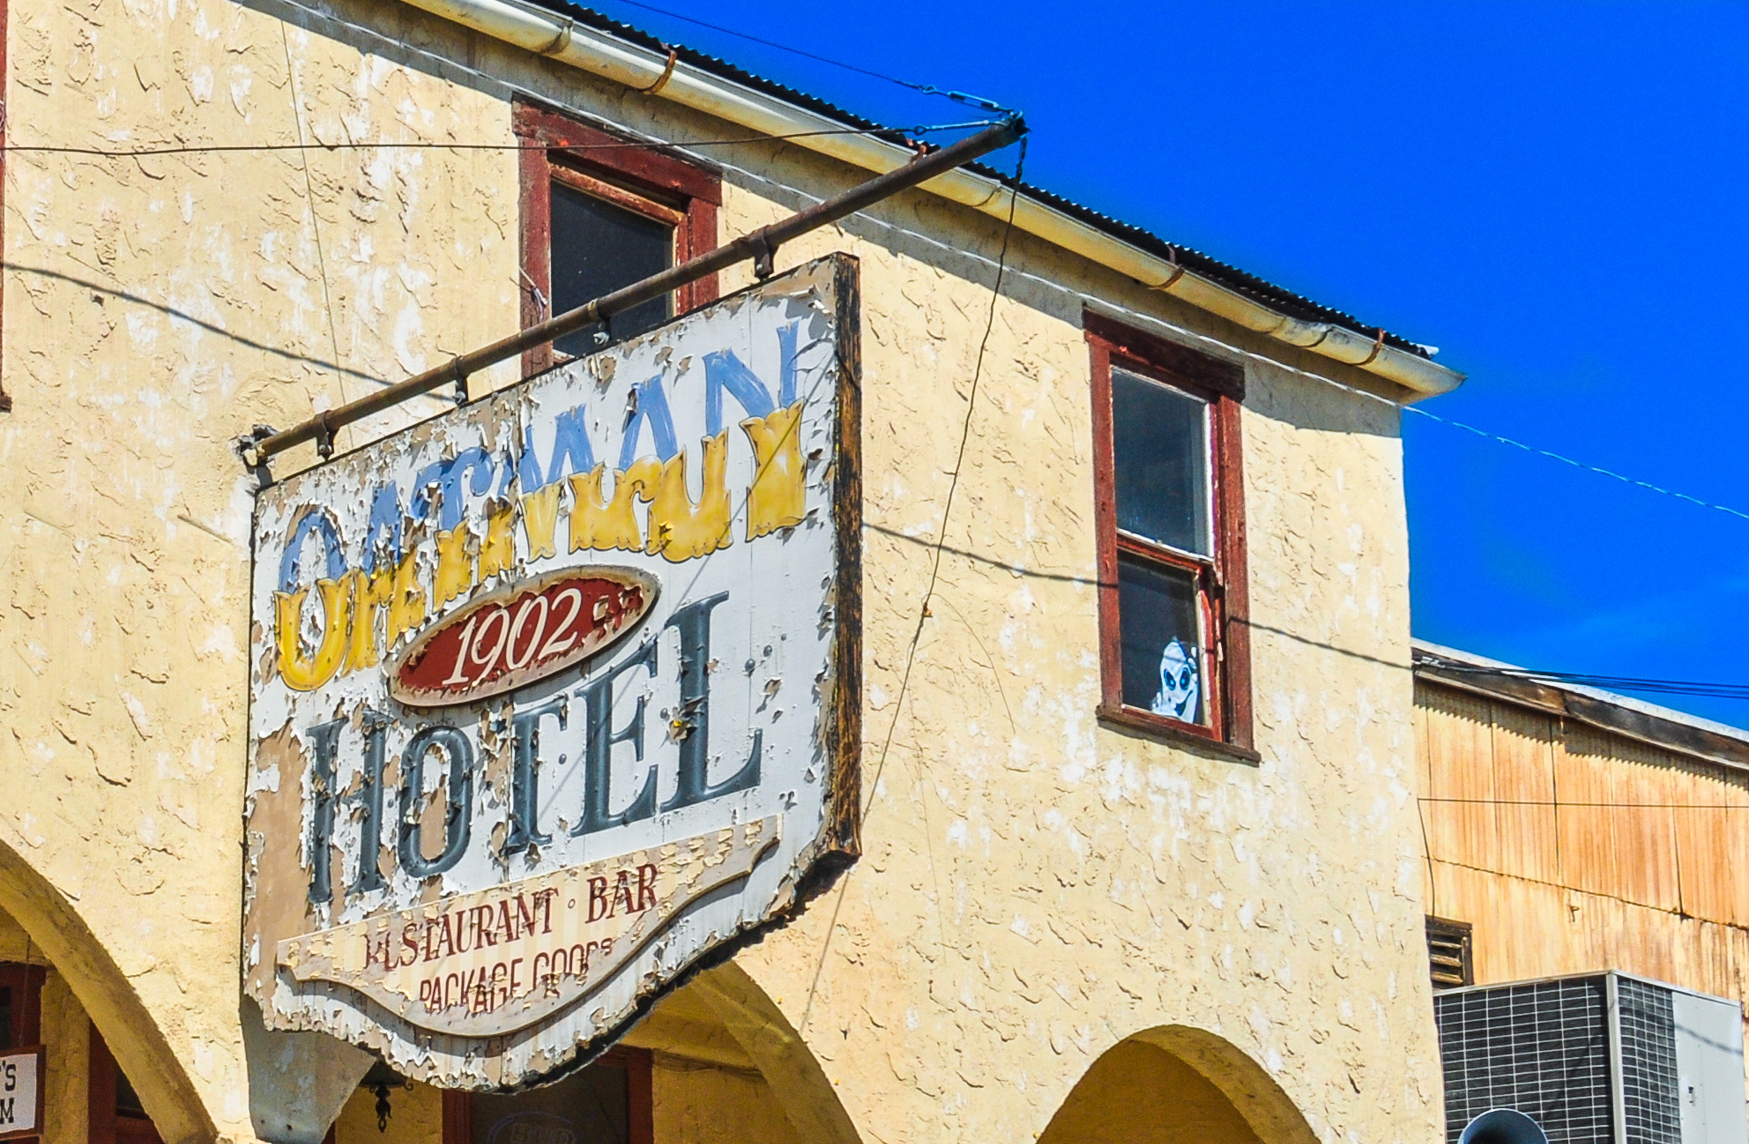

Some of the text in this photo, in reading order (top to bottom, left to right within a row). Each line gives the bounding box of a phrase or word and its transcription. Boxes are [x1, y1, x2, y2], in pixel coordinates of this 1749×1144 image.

[274, 320, 807, 691] OATMAN
[442, 588, 583, 687] 1902
[306, 591, 762, 903] HOTEL
[585, 864, 659, 924] BAR
[419, 957, 524, 1013] PACKAGE
